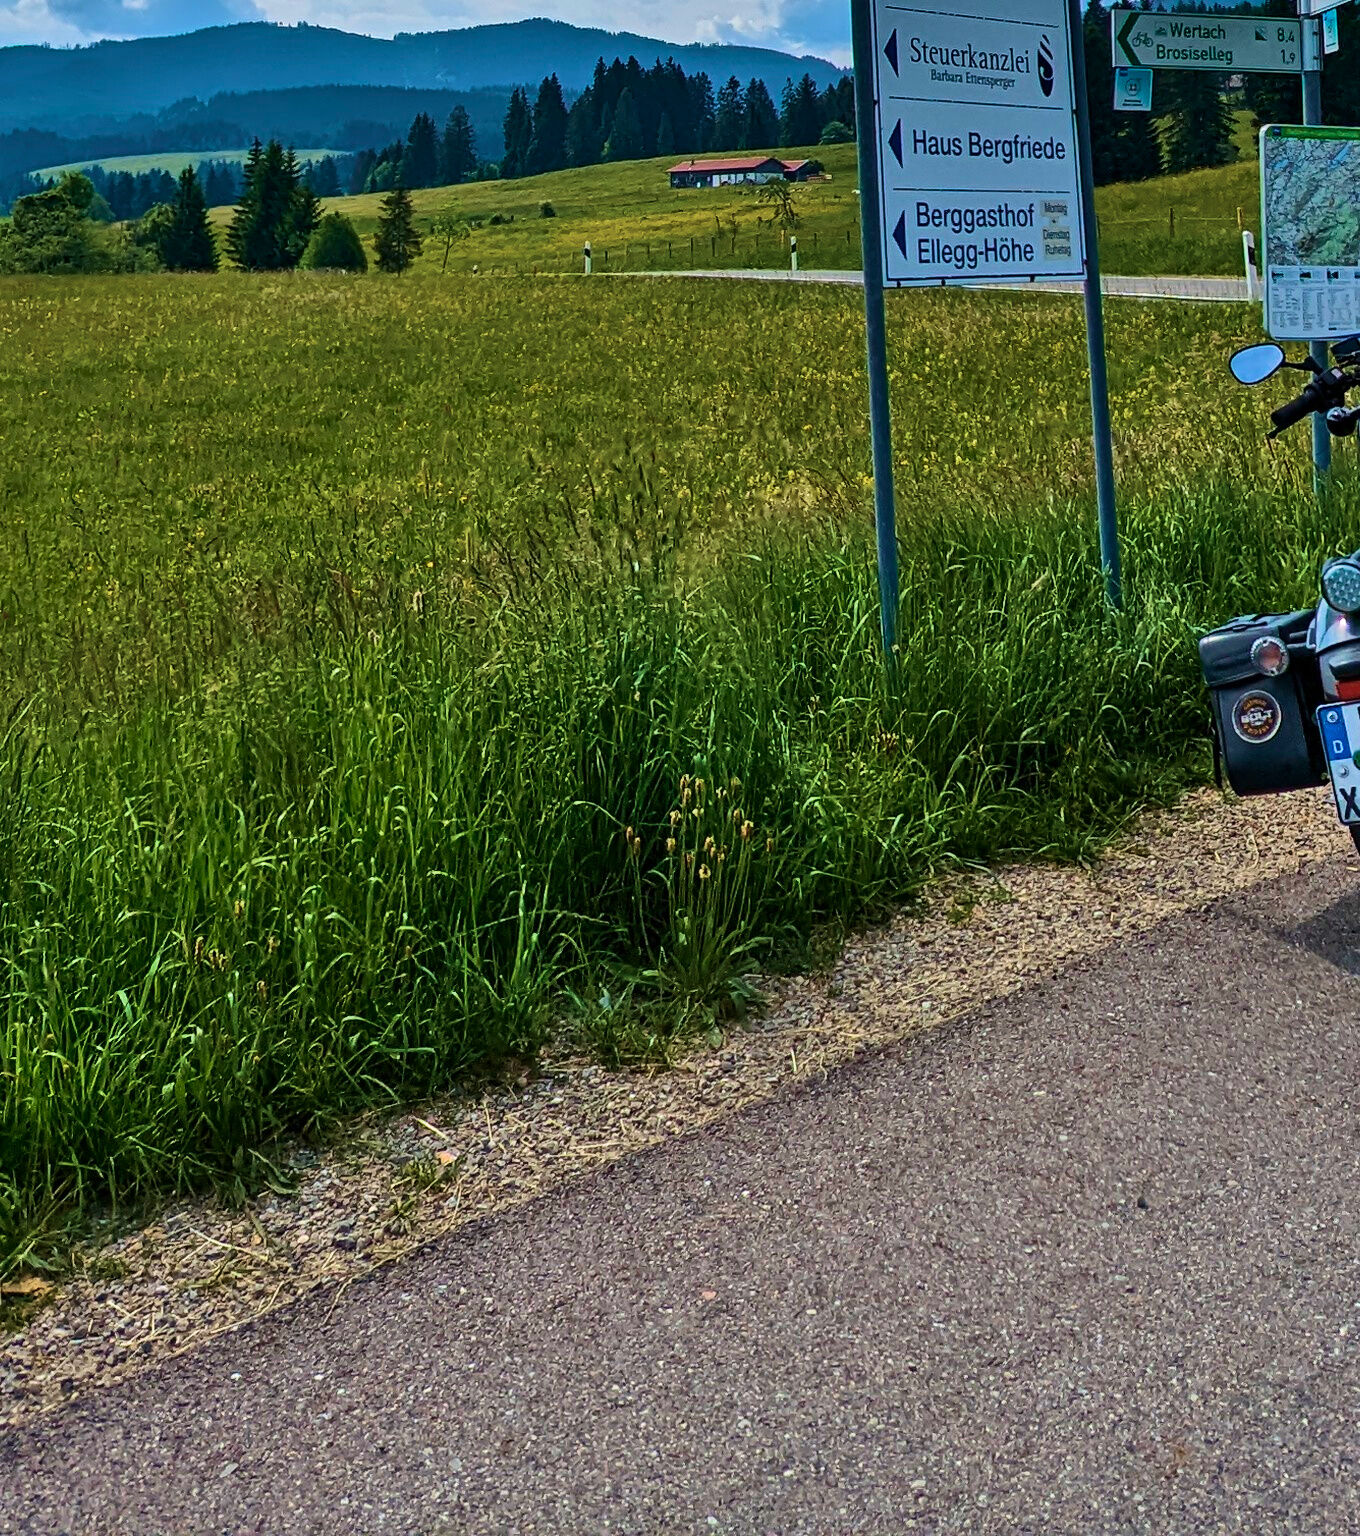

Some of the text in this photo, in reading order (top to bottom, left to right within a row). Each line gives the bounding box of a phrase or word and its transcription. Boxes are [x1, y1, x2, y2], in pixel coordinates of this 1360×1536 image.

[1169, 22, 1226, 40] Wertach
[910, 37, 1031, 74] Steuerkanzlei
[1156, 44, 1234, 65] Brosiselleg
[930, 69, 1016, 90] Barbara Ettensperger
[912, 129, 1066, 164] Haus Bergfriede
[916, 202, 1035, 234] Berggasthof
[918, 237, 1035, 270] Ellegg-Höhe
[1241, 709, 1273, 724] BOLT
[1332, 739, 1344, 754] D
